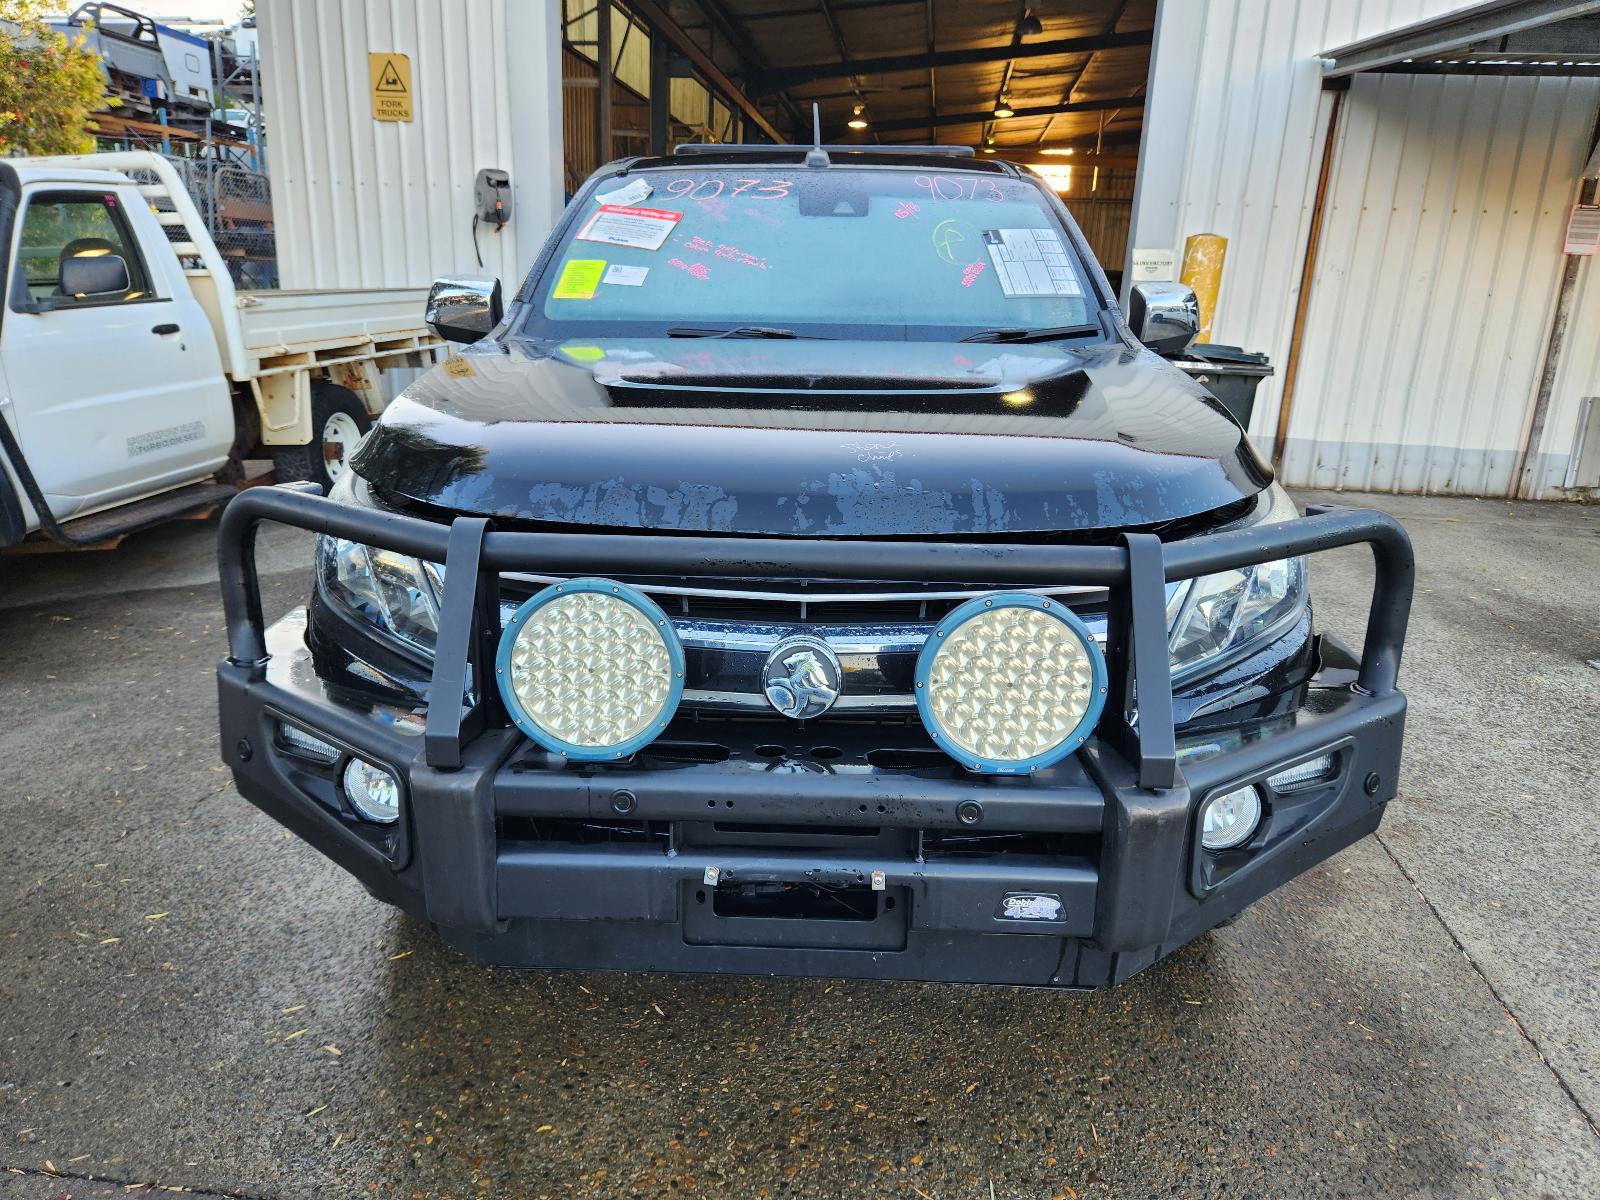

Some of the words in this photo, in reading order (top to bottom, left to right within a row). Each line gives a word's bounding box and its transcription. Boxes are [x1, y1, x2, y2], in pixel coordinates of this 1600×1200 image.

[381, 100, 403, 109] FORK
[376, 109, 410, 118] TRUCKS
[656, 179, 794, 200] 9073
[914, 175, 1004, 203] 9073
